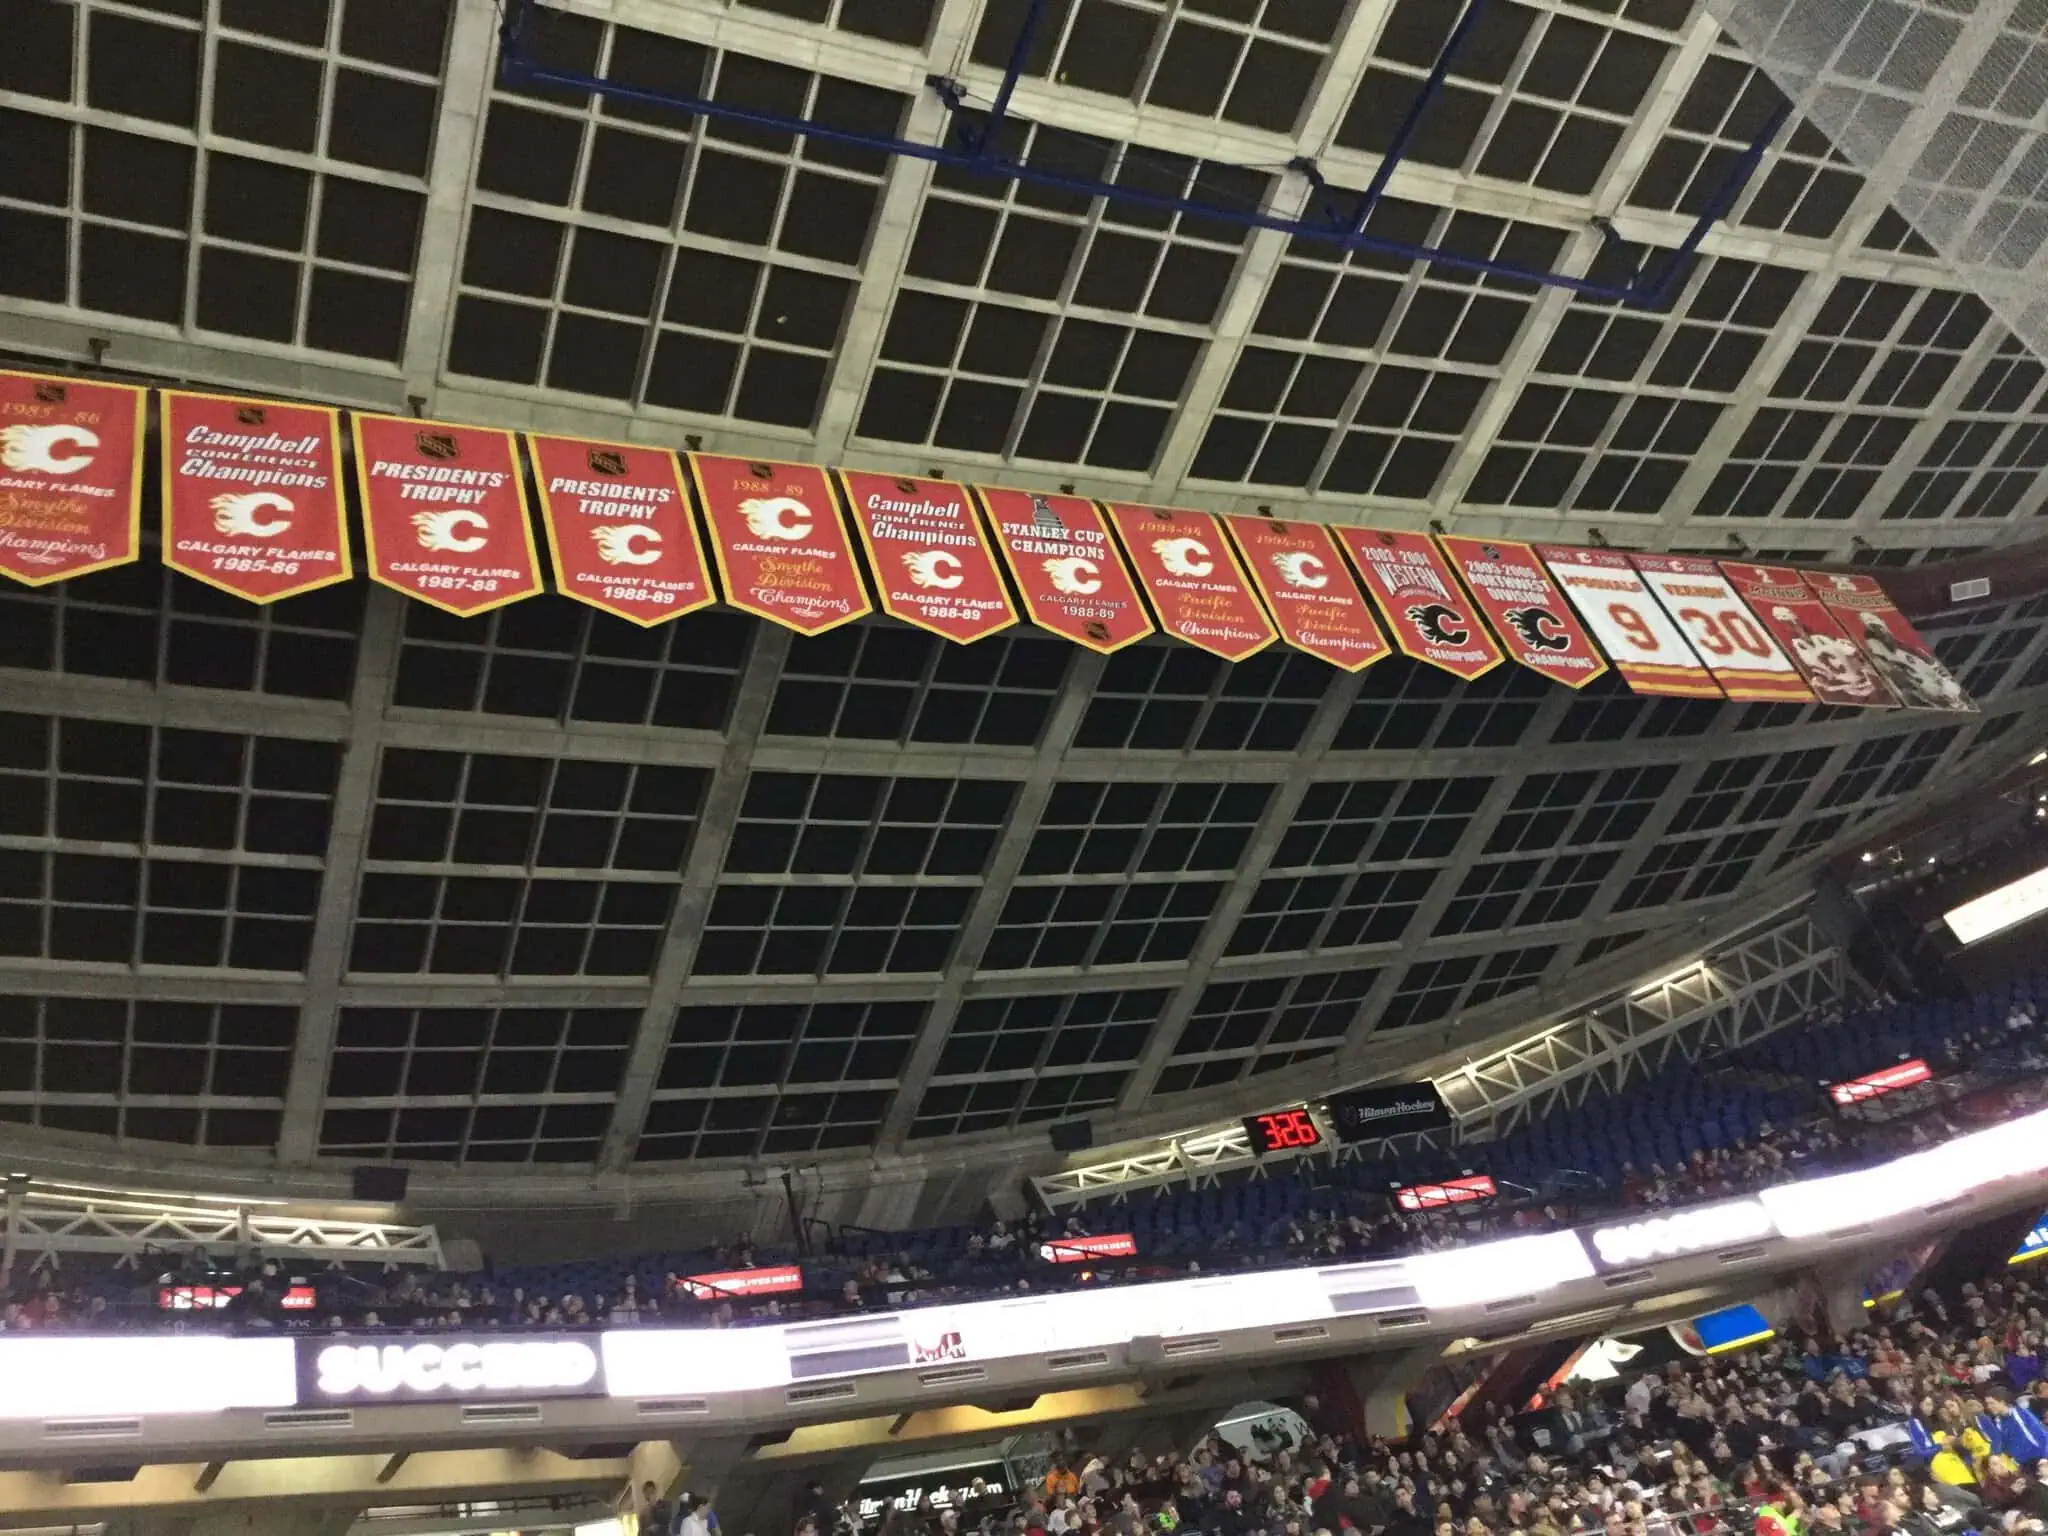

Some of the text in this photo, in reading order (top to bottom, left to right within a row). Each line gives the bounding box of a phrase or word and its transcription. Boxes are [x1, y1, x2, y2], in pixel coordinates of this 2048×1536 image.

[185, 425, 320, 454] Campbell
[185, 448, 319, 469] CONFERENCE
[179, 457, 328, 489] Champions
[371, 460, 511, 488] PRESIDENTS'
[0, 478, 115, 498] GARY FLAMES
[400, 483, 487, 504] TROPHY
[549, 477, 676, 503] PRESIDENTS'
[578, 499, 657, 520] TROPHY
[867, 494, 960, 518] Campbell
[871, 513, 967, 530] CONFERENCE
[872, 521, 977, 547] Champions
[1002, 522, 1105, 544] STANLEY CUP
[176, 540, 337, 561] CALGARY FLAMES
[732, 543, 837, 560] CALGARY FLAMES
[1011, 539, 1105, 561] CHAMPIONS
[211, 556, 299, 575] 1985-86
[389, 562, 521, 580] CALGARY FLAMES
[755, 556, 824, 574] Smythe
[417, 575, 499, 592] 1987-88
[576, 572, 695, 591] CALGARY FLAMES
[753, 573, 833, 593] Division
[1155, 578, 1238, 593] CALGARY FLAMES
[1372, 561, 1455, 604] WESTERN
[602, 585, 676, 605] 1988-89
[750, 587, 851, 613] Champions
[891, 592, 1004, 610] CALGARY FLAMES
[1039, 594, 1128, 609] CALGARY FLAMES
[1178, 592, 1233, 610] Pacific
[1275, 591, 1353, 605] CALGARY FLAMES
[920, 605, 981, 621] 1988-89
[1061, 606, 1115, 620] 1988-89
[1295, 603, 1349, 621] Pacific
[1175, 619, 1262, 641] Champions
[1608, 602, 1660, 652] 9
[1678, 608, 1772, 657] 30
[1295, 629, 1378, 650] Champions
